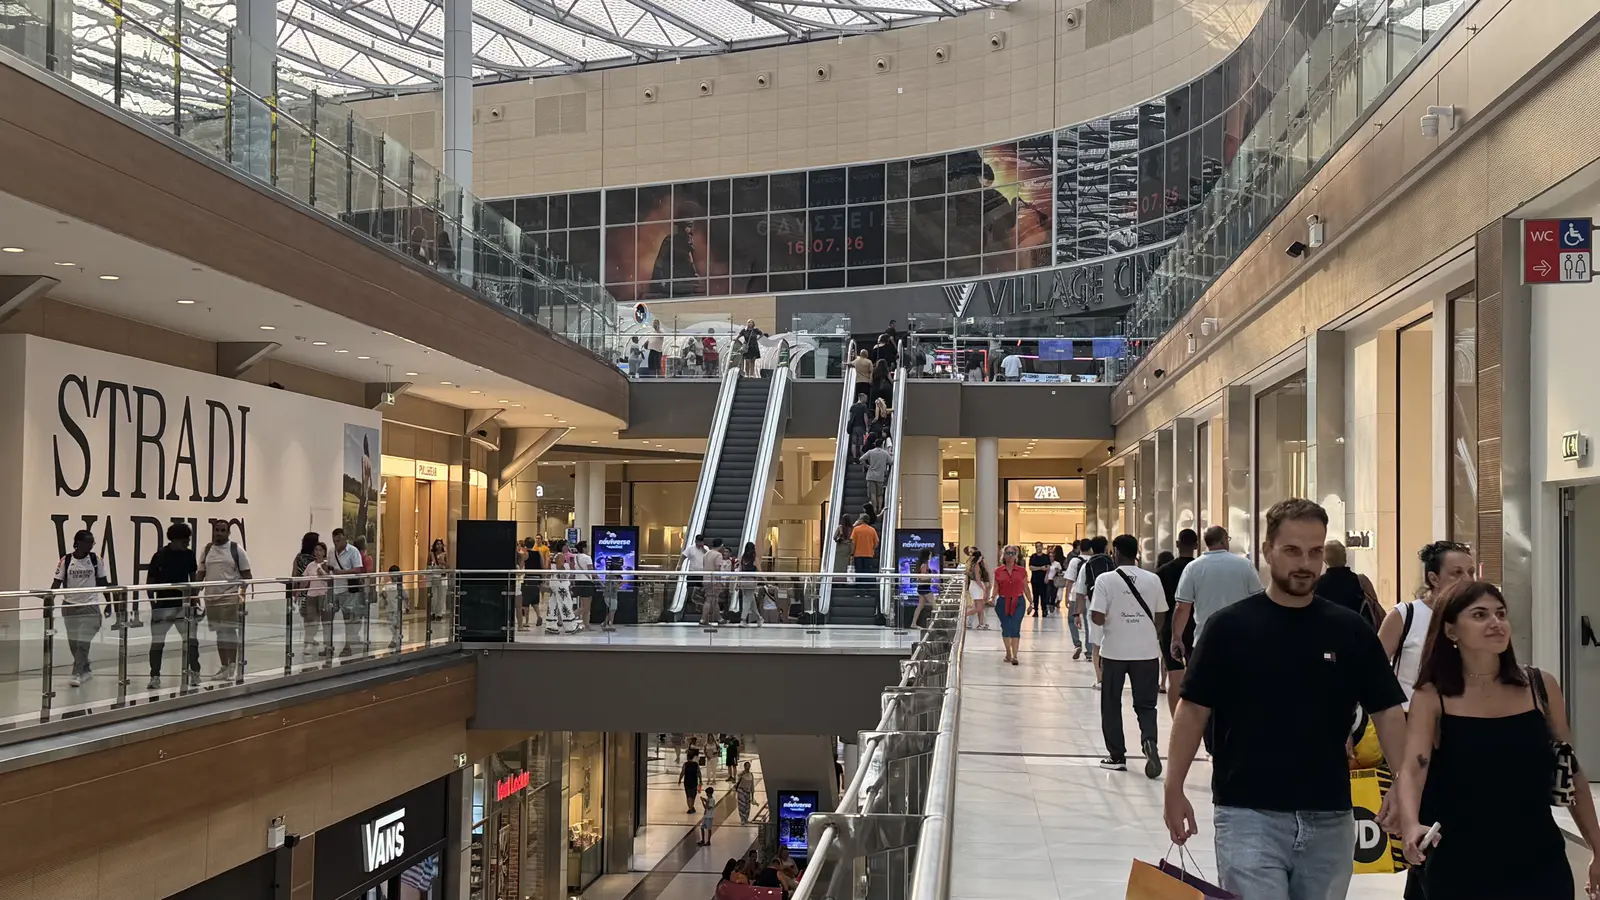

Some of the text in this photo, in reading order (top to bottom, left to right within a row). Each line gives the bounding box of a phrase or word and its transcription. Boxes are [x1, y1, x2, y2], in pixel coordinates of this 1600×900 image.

[1530, 230, 1554, 242] WC
[984, 263, 1104, 317] VILLAGE
[53, 373, 250, 504] STRADI
[364, 807, 406, 873] VANS
